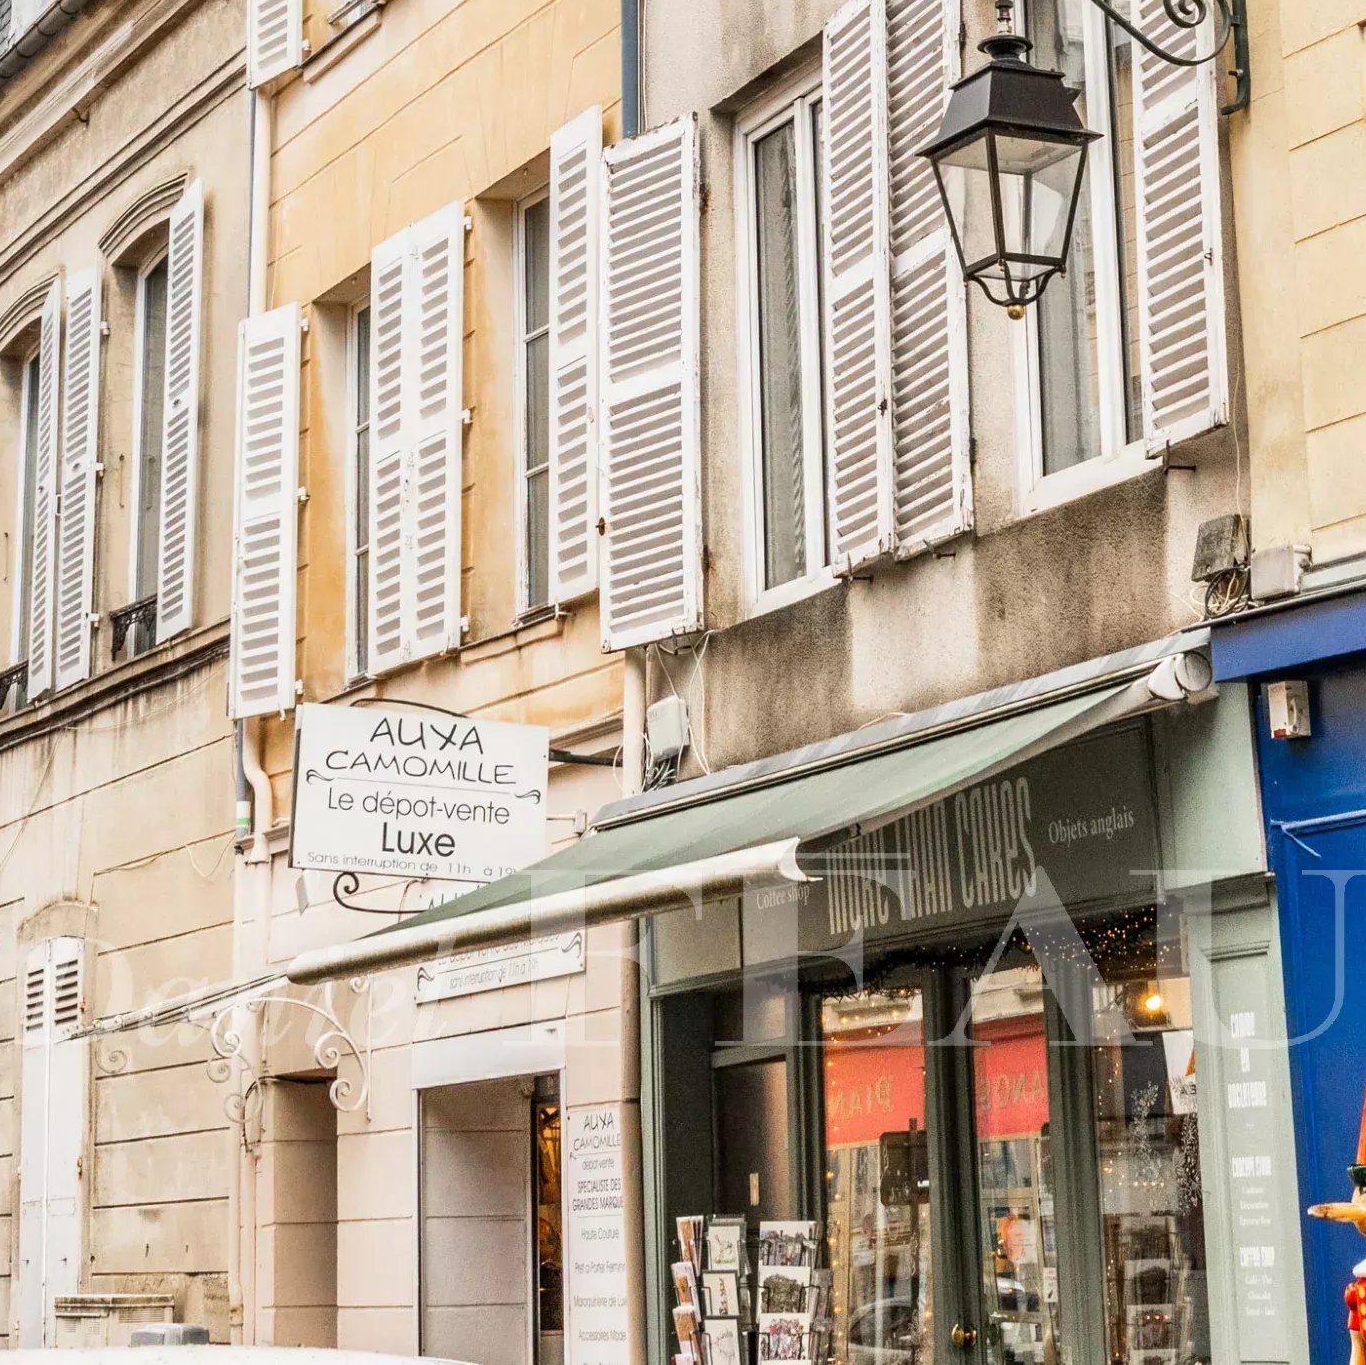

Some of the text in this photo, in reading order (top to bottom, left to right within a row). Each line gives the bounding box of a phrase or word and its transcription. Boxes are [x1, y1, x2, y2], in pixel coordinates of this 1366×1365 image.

[369, 717, 484, 754] AUXA
[325, 750, 516, 784] CAMOMILLE
[328, 787, 510, 825] Le dépot-vente
[381, 822, 456, 857] Luxe
[1048, 805, 1135, 848] Objets anglais
[307, 851, 339, 865] Sans
[342, 854, 416, 872] interruption
[420, 862, 439, 873] de
[448, 864, 472, 875] 11h
[755, 885, 811, 911] Coffee shop
